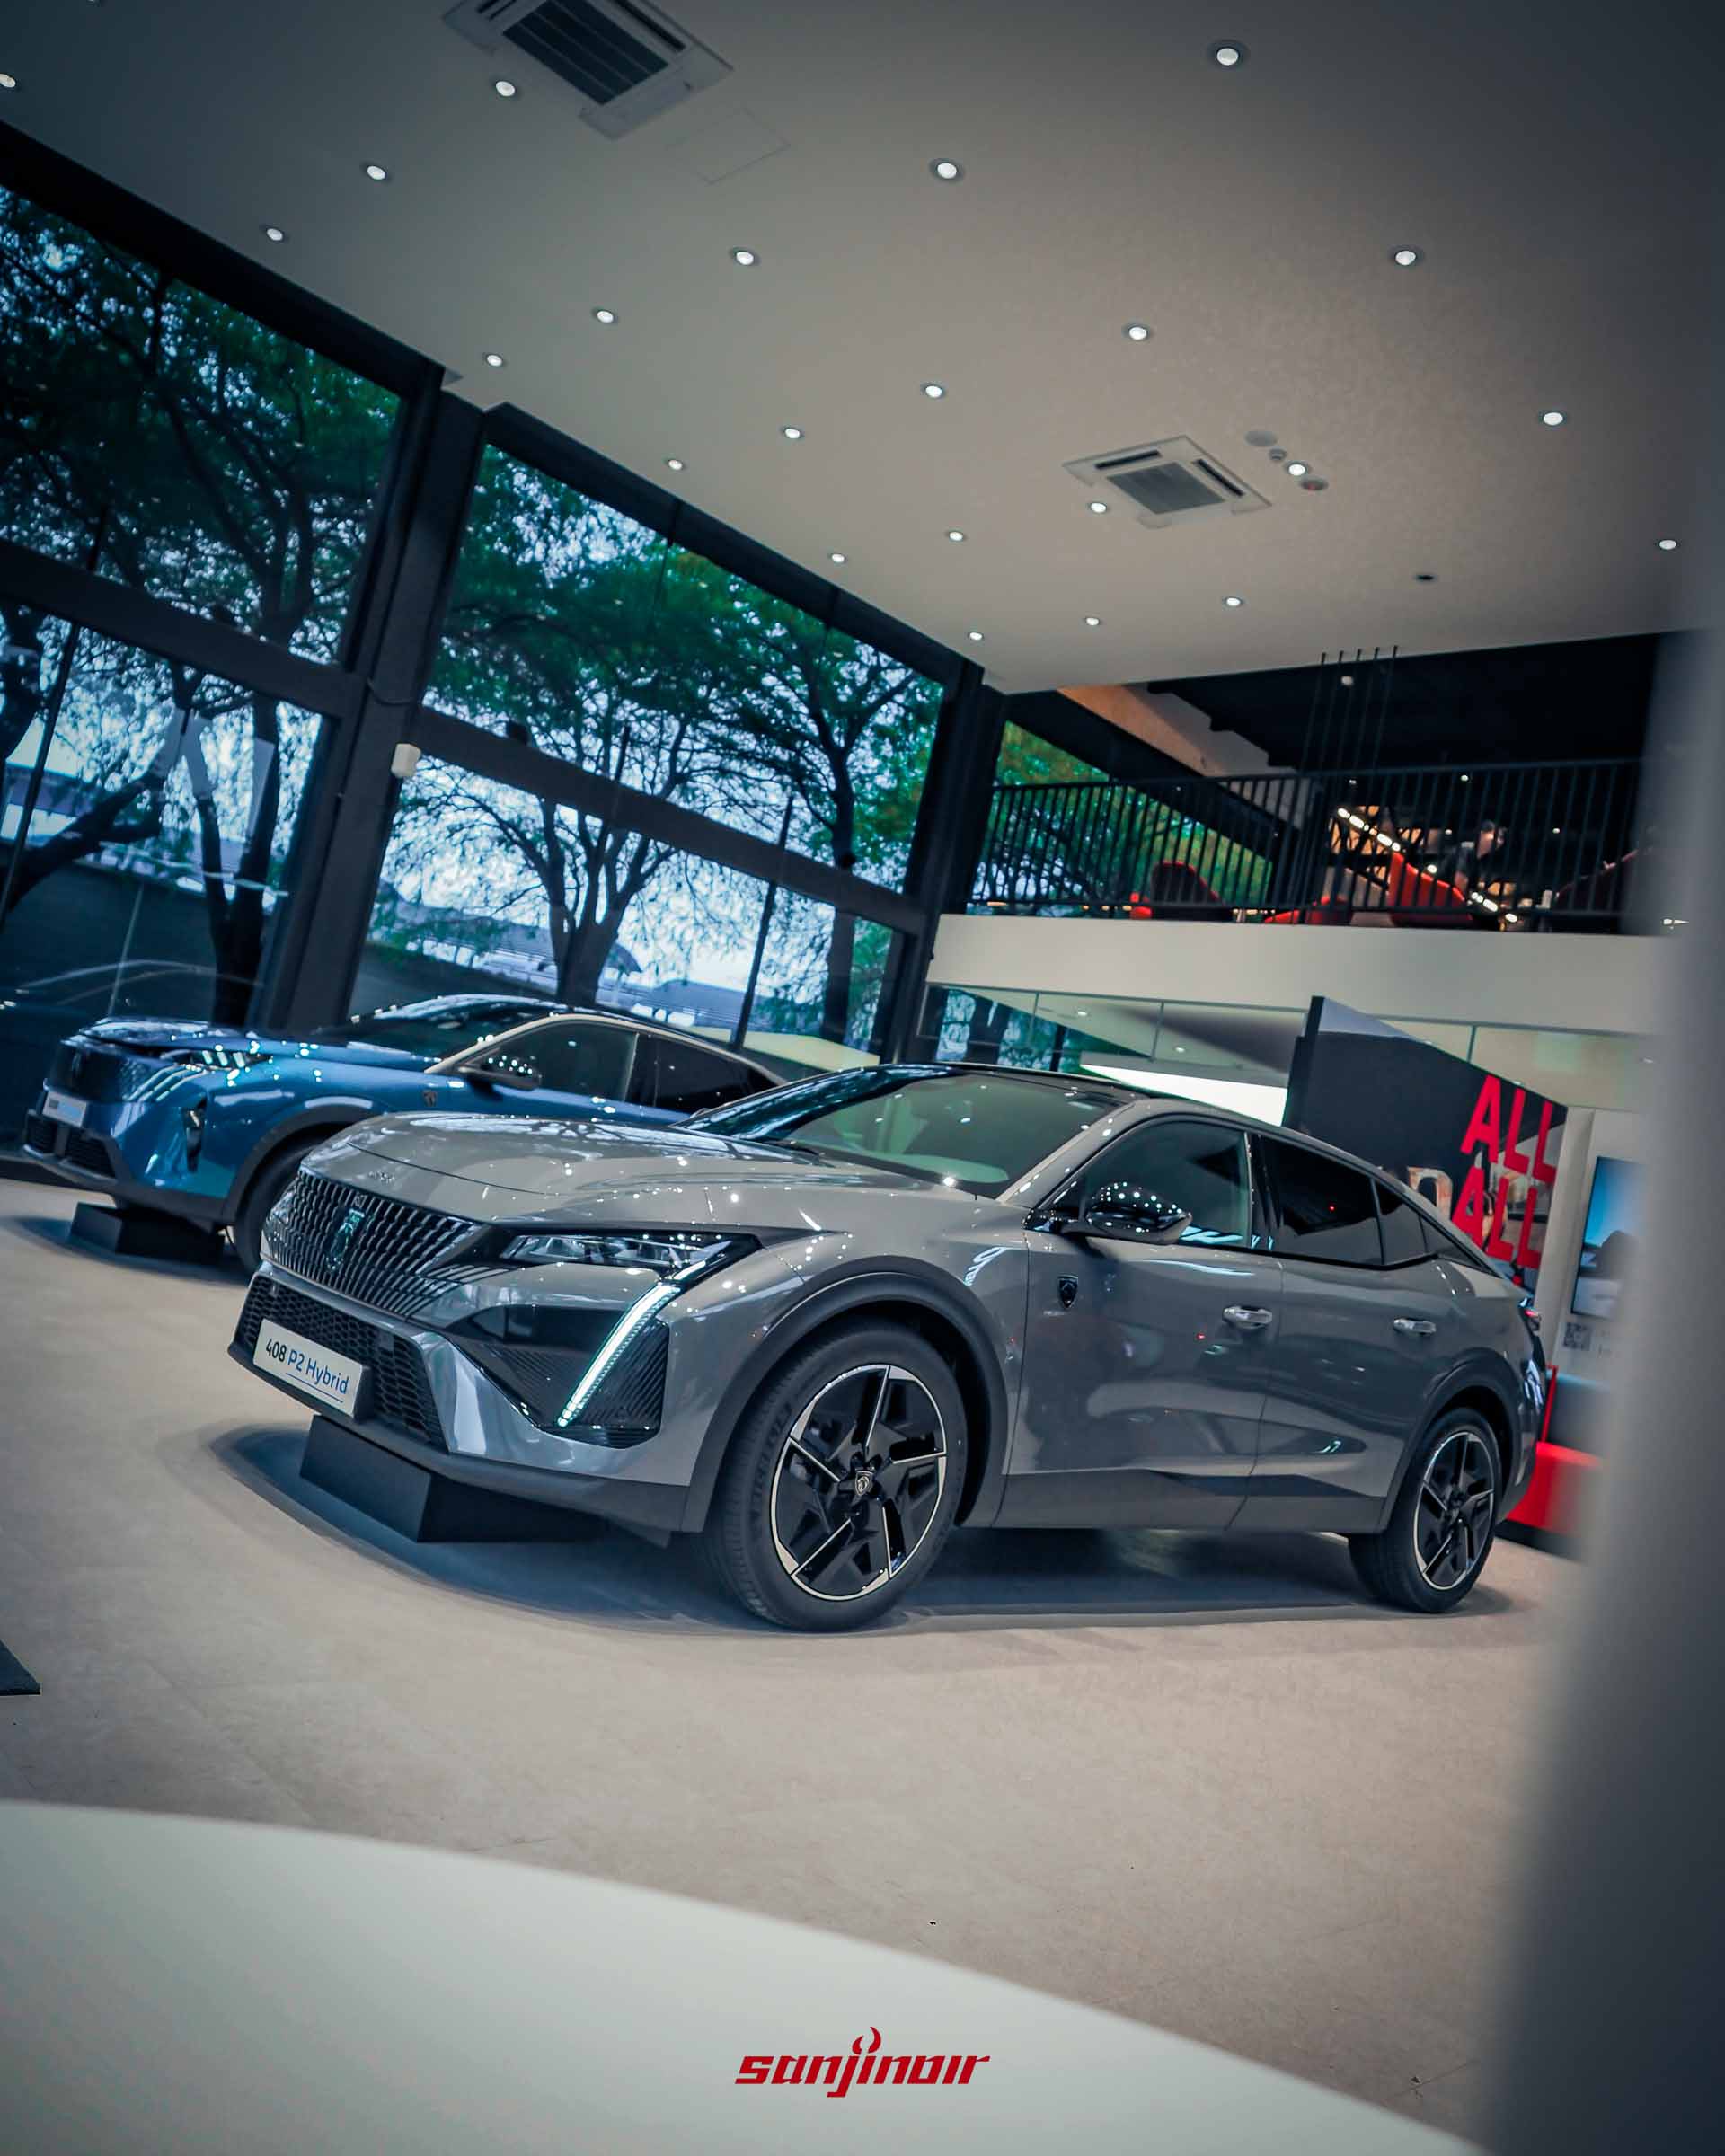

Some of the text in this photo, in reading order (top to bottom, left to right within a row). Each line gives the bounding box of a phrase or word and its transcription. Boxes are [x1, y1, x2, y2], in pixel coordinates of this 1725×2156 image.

[1460, 1074, 1557, 1185] ALL
[1451, 1165, 1542, 1269] ALL
[265, 1339, 349, 1394] 408 P2 Hybrid
